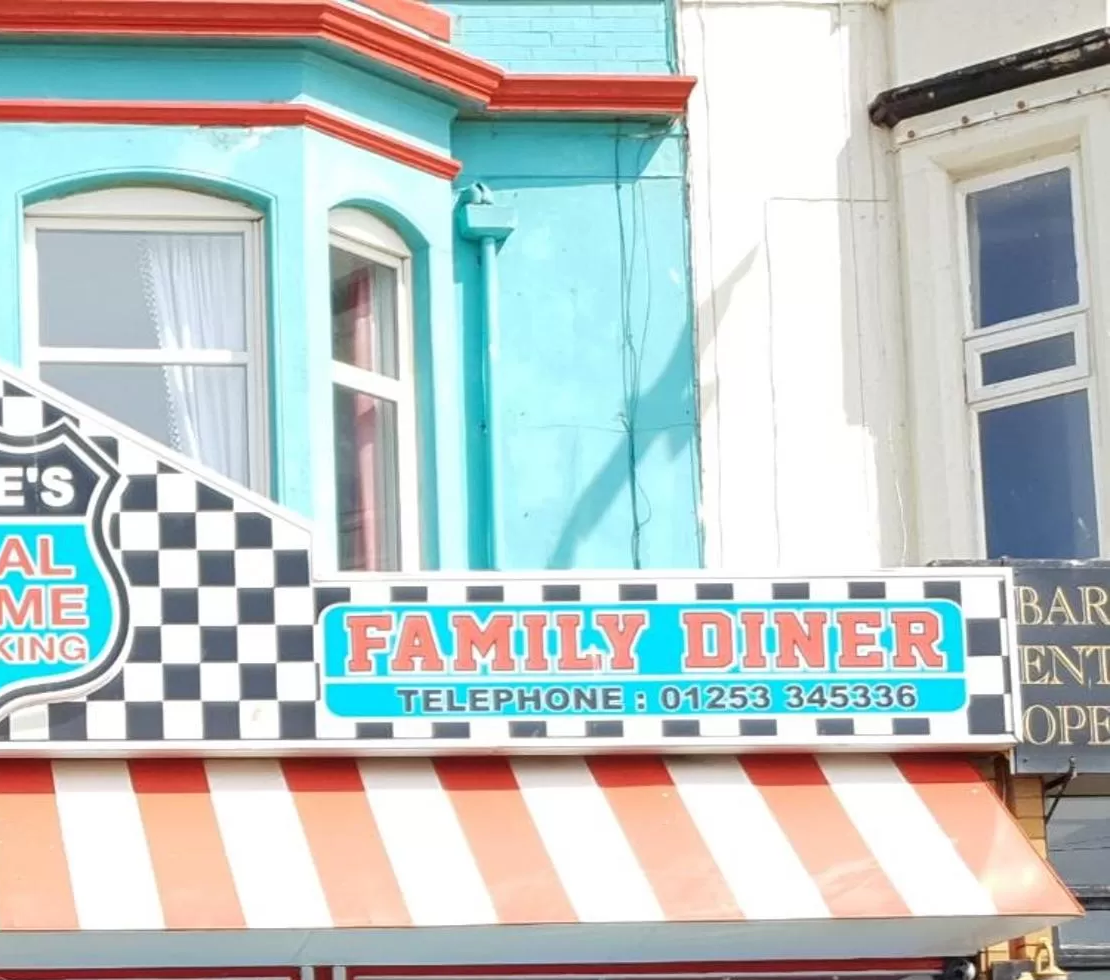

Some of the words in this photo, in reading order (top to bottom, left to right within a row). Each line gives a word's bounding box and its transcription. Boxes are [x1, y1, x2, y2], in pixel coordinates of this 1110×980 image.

[1014, 586, 1110, 626] BAR
[346, 613, 646, 672] FAMILY
[682, 611, 944, 669] DINER
[397, 687, 622, 712] TELEPHONE
[661, 686, 770, 709] 01253
[785, 684, 917, 709] 345336
